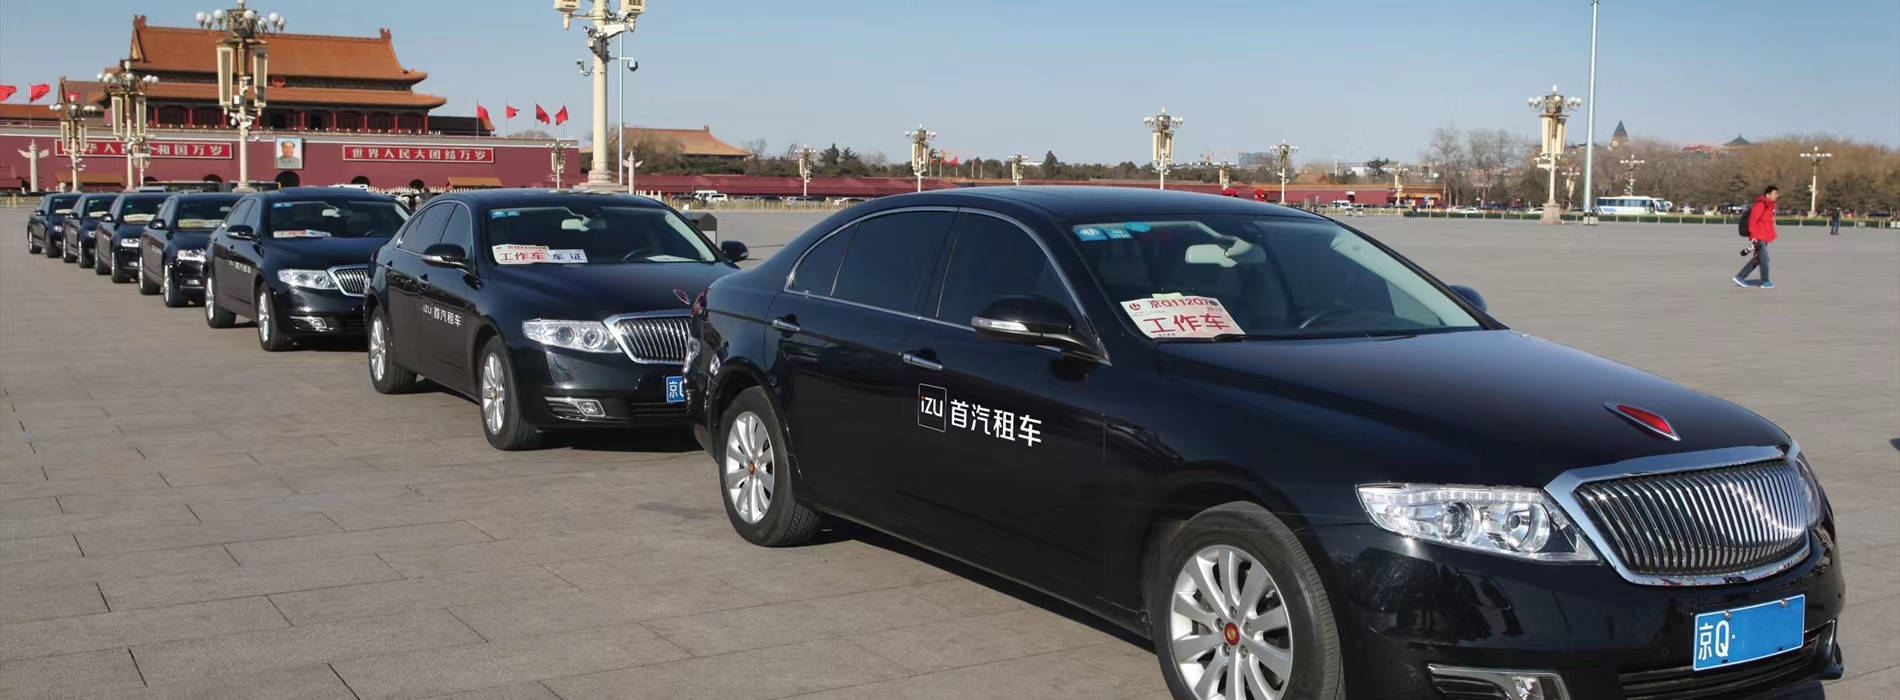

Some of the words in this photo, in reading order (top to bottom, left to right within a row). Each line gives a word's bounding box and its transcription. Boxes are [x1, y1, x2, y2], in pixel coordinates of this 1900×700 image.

[67, 144, 222, 156] 华人和国万岁
[352, 148, 486, 160] 世界人民大团结万岁
[499, 252, 545, 261] 工作车
[433, 306, 462, 327] 首汽租车
[1143, 313, 1230, 333] 工作车
[950, 399, 1042, 447] 首汽租车
